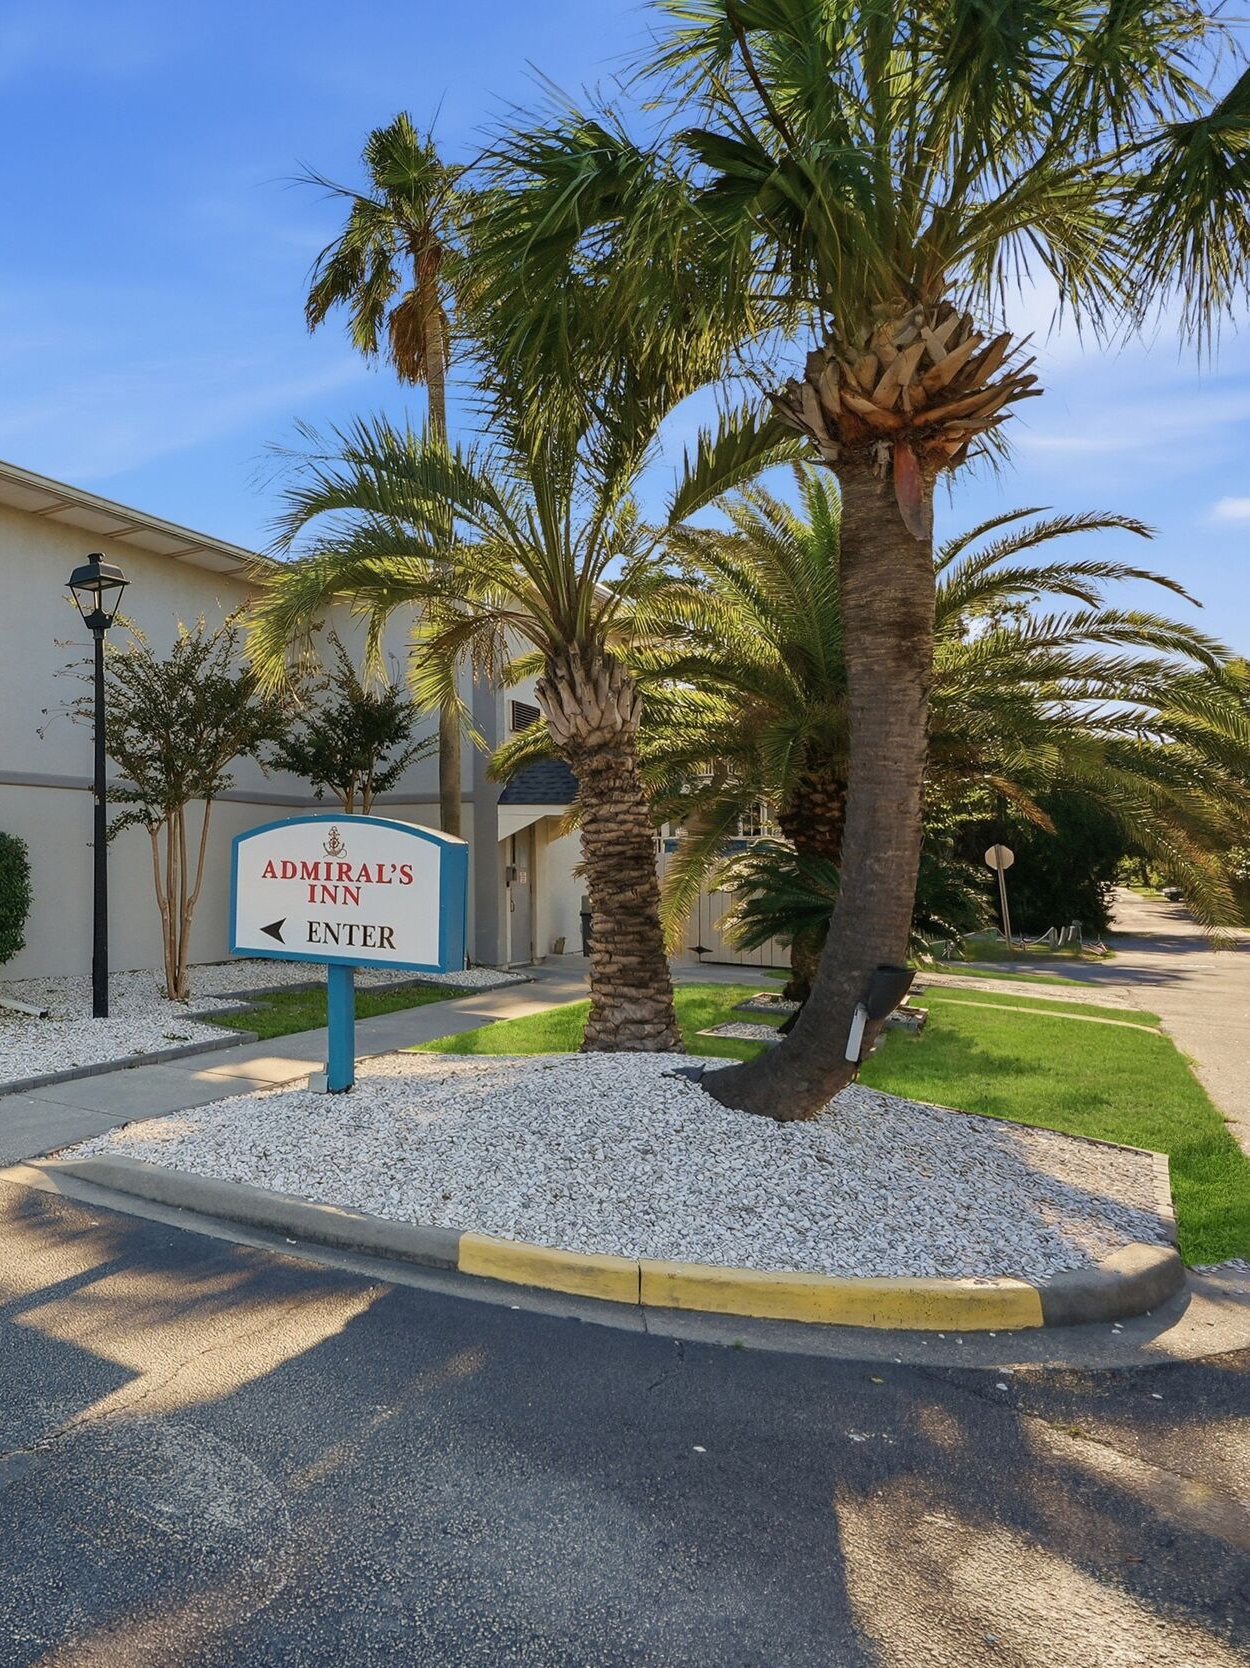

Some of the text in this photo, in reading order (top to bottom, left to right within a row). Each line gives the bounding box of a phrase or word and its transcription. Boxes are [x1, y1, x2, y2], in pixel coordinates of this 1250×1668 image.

[261, 859, 414, 885] ADMIRAL'S
[307, 884, 361, 906] INN
[306, 920, 396, 950] ENTER
